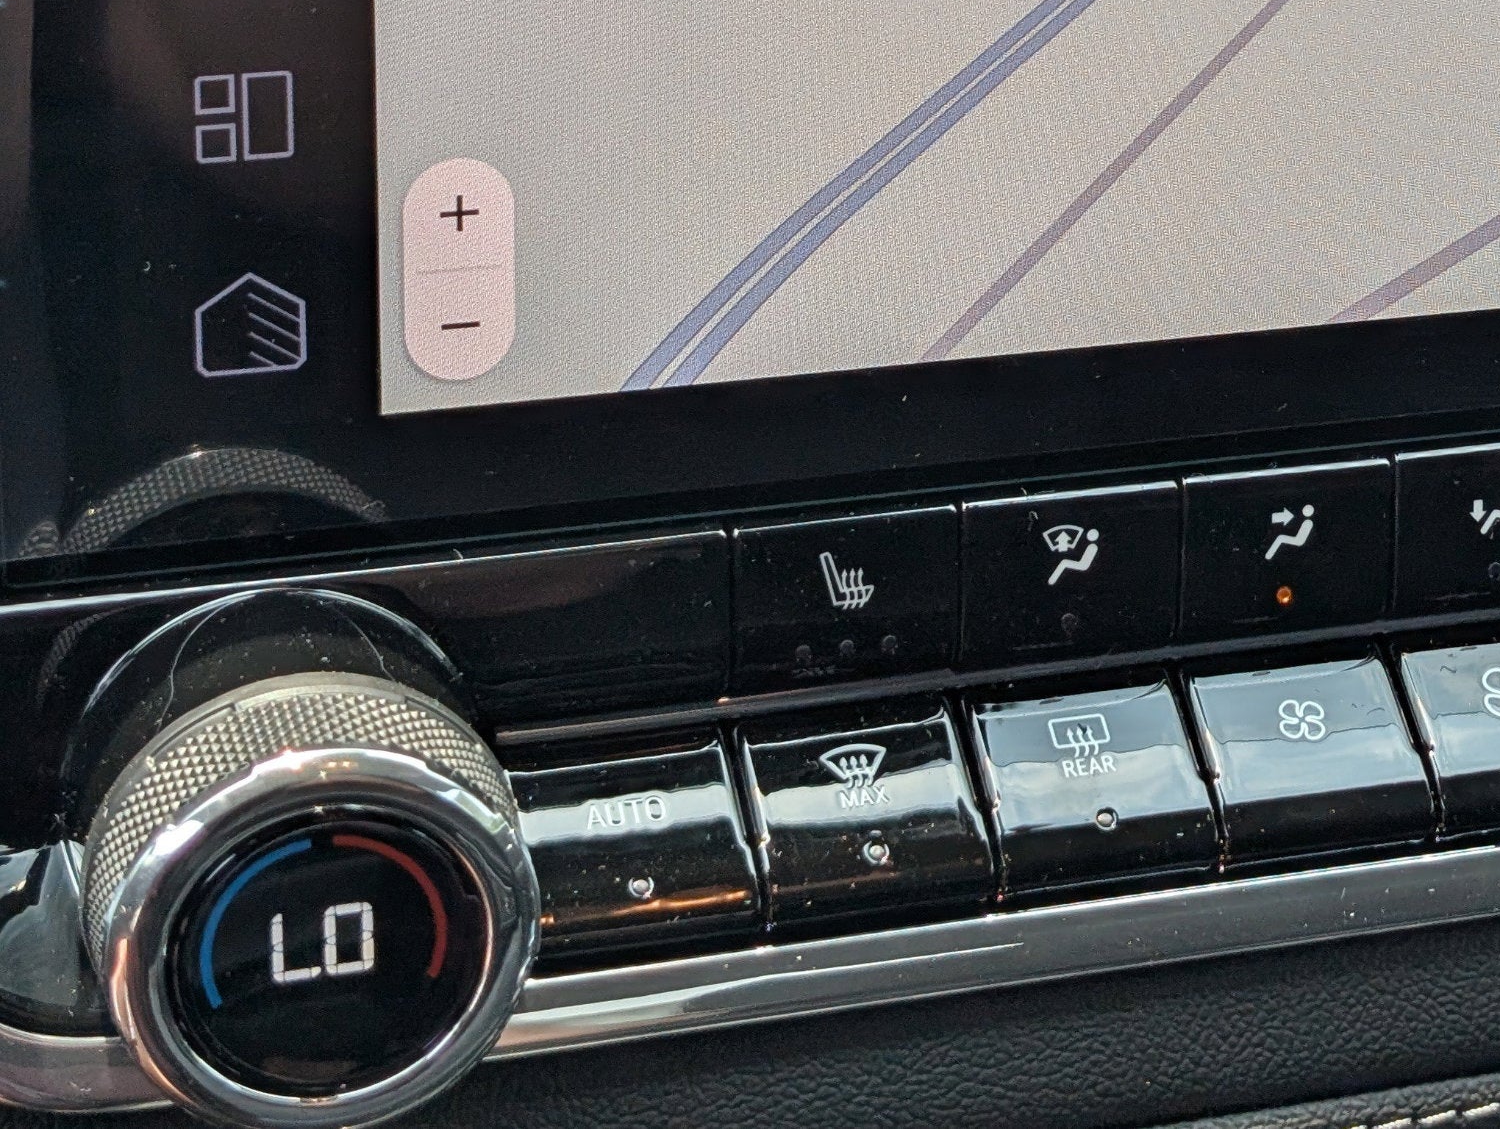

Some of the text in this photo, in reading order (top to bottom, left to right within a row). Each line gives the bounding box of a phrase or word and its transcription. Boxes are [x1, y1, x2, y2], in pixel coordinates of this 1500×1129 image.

[1062, 753, 1117, 779] REAR
[840, 785, 889, 809] MAX
[585, 795, 667, 832] AUTO
